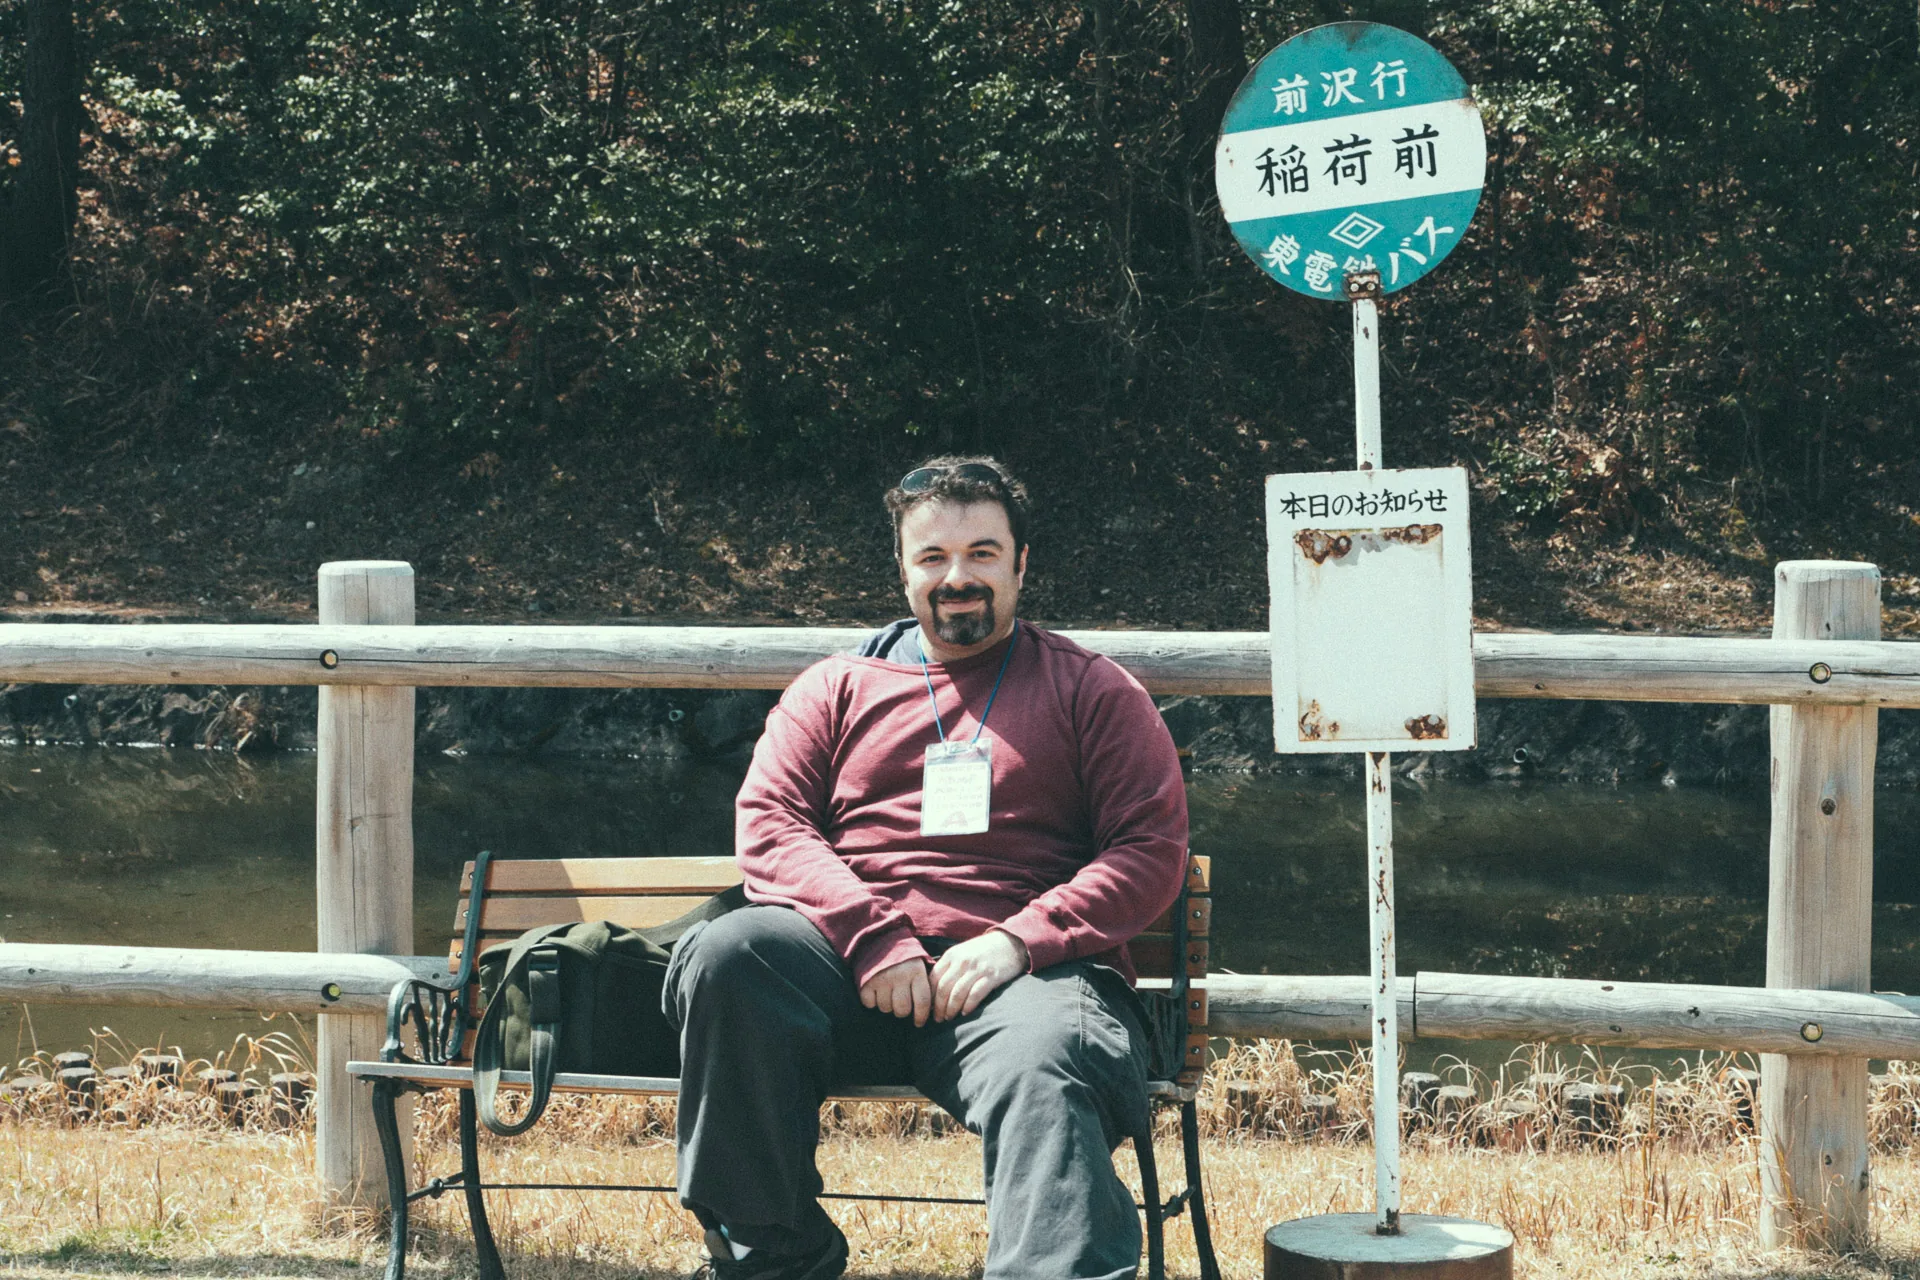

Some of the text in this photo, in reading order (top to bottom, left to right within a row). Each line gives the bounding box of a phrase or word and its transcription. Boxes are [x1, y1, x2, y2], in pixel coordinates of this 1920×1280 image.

[1271, 59, 1408, 115] 前沢行
[1254, 123, 1440, 197] 稲荷前
[1280, 488, 1448, 520] 本日のお知らせ
